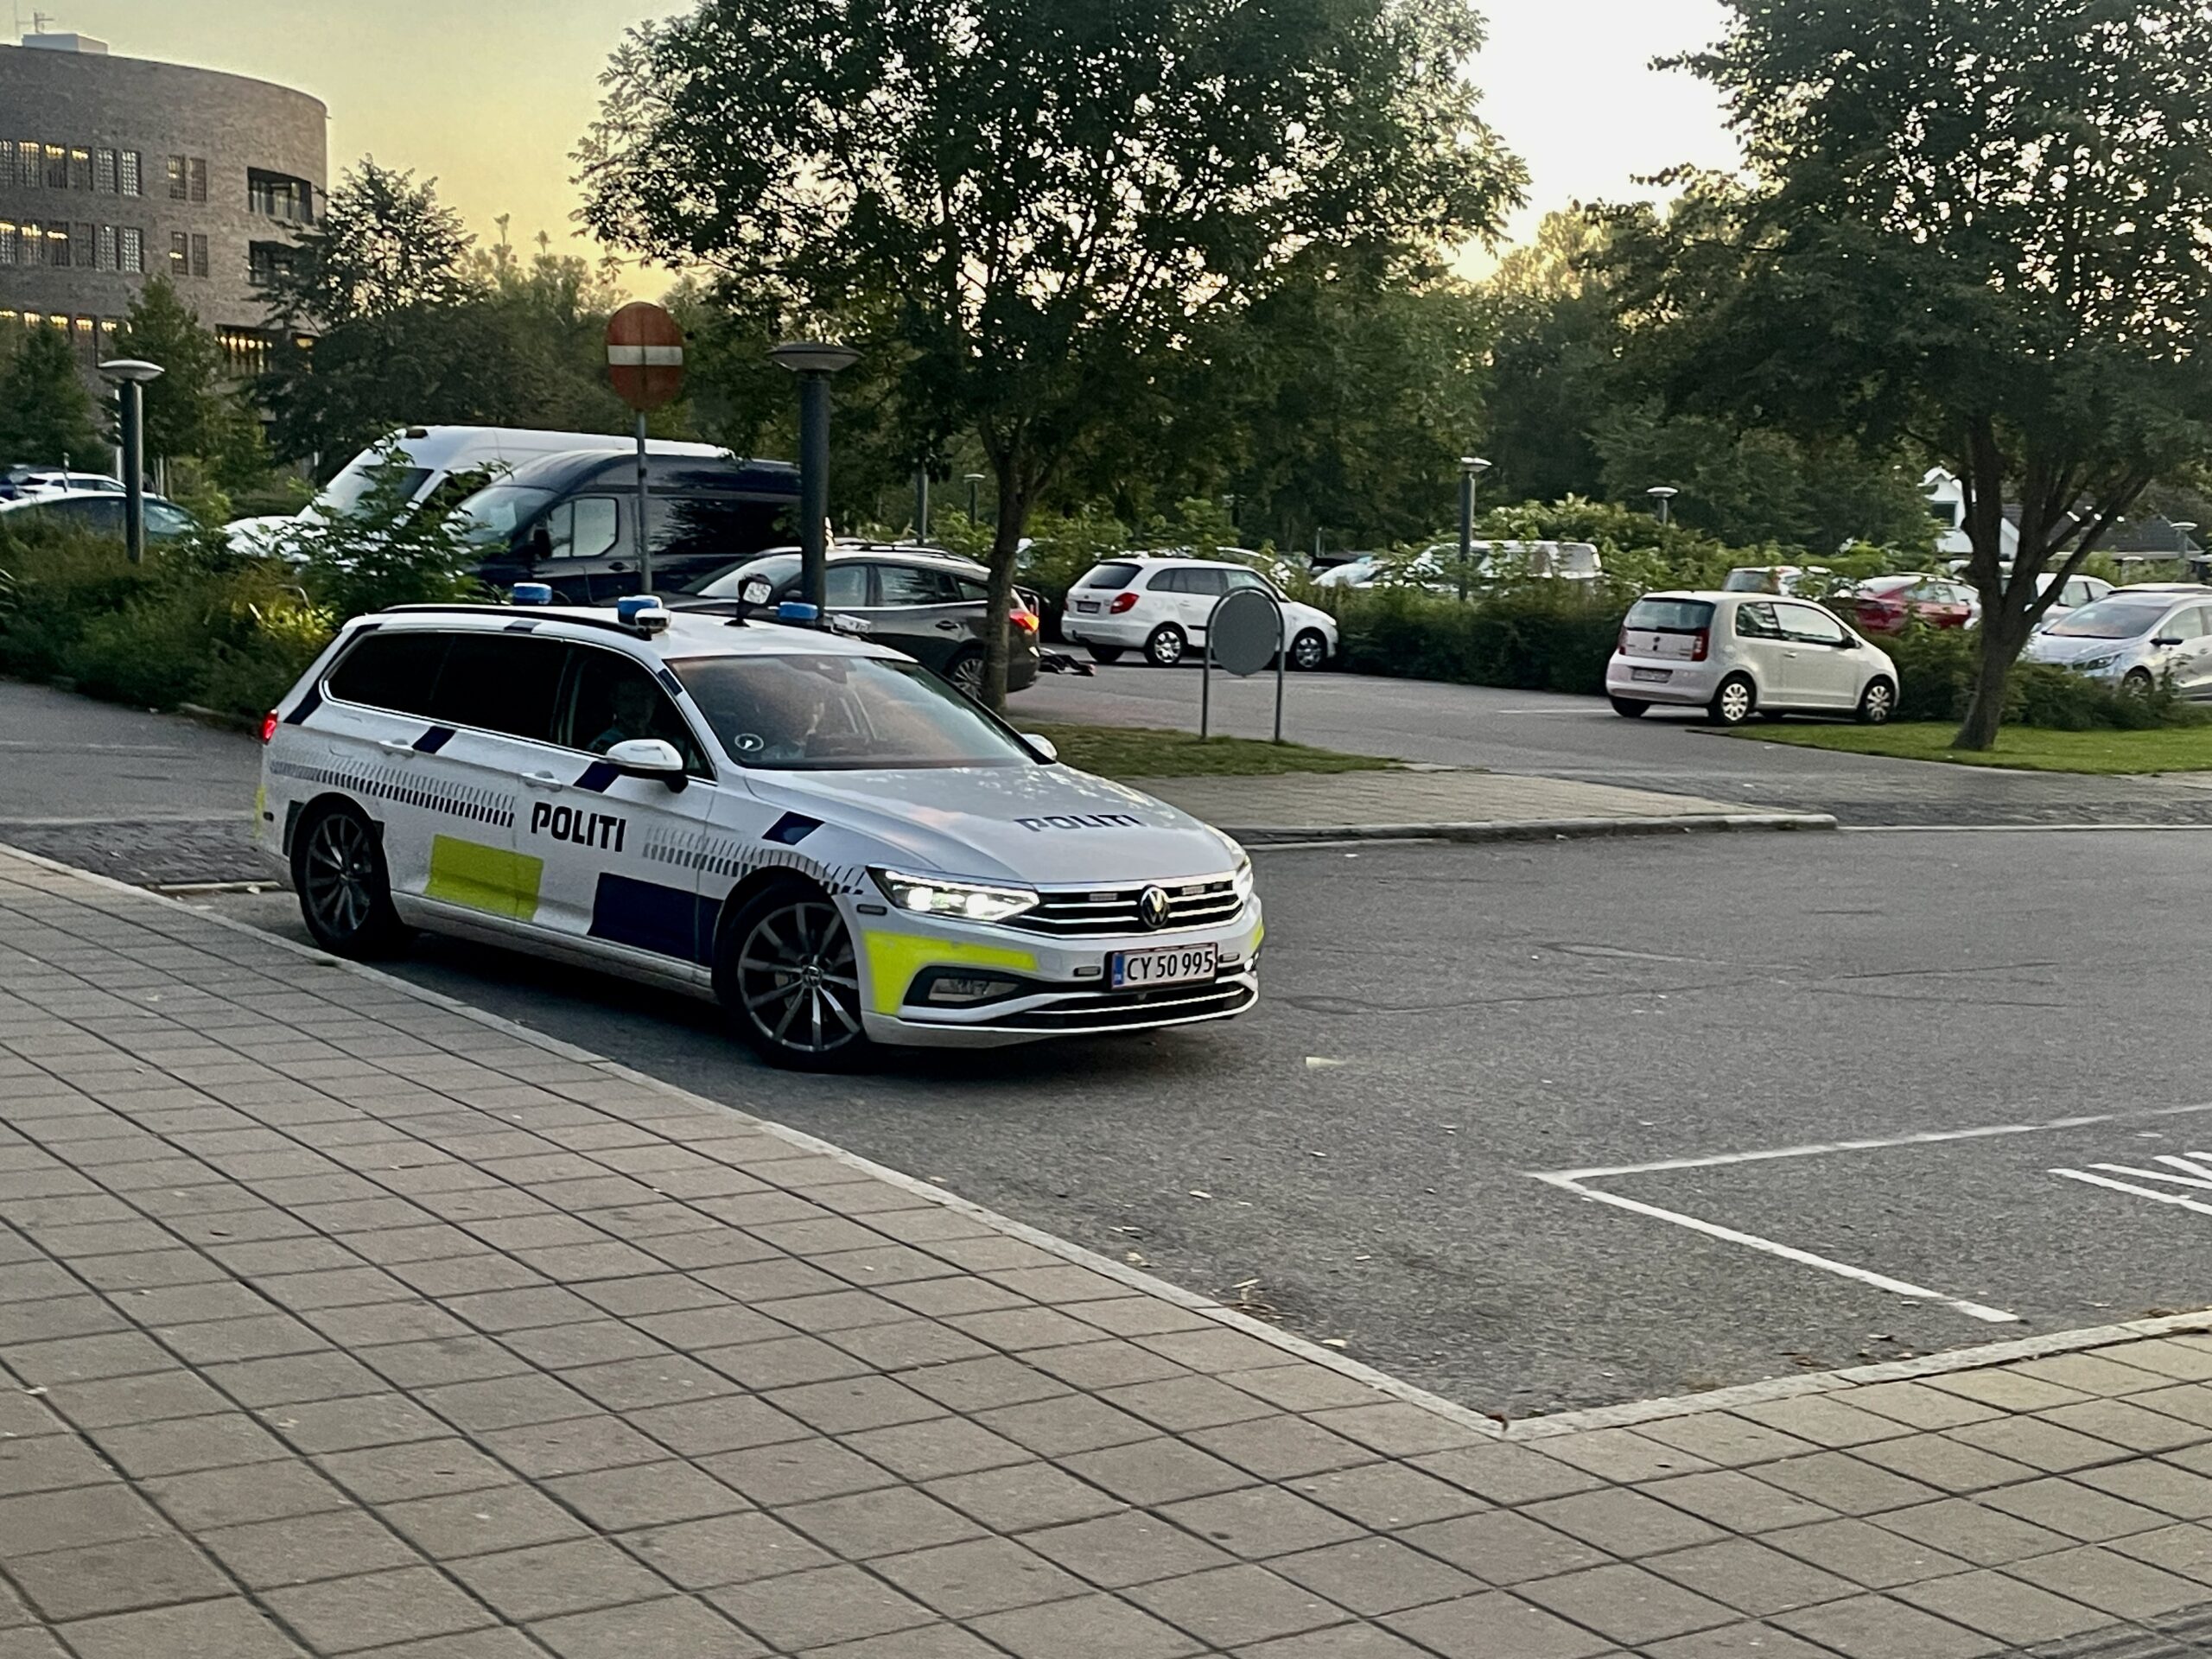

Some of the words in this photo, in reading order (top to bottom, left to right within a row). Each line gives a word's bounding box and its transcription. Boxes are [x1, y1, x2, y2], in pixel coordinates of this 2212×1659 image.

[531, 801, 626, 853] POLITI
[1013, 814, 1147, 832] POLITI
[1127, 956, 1153, 981] CY
[1155, 954, 1178, 978] 50
[1181, 950, 1214, 976] 995
